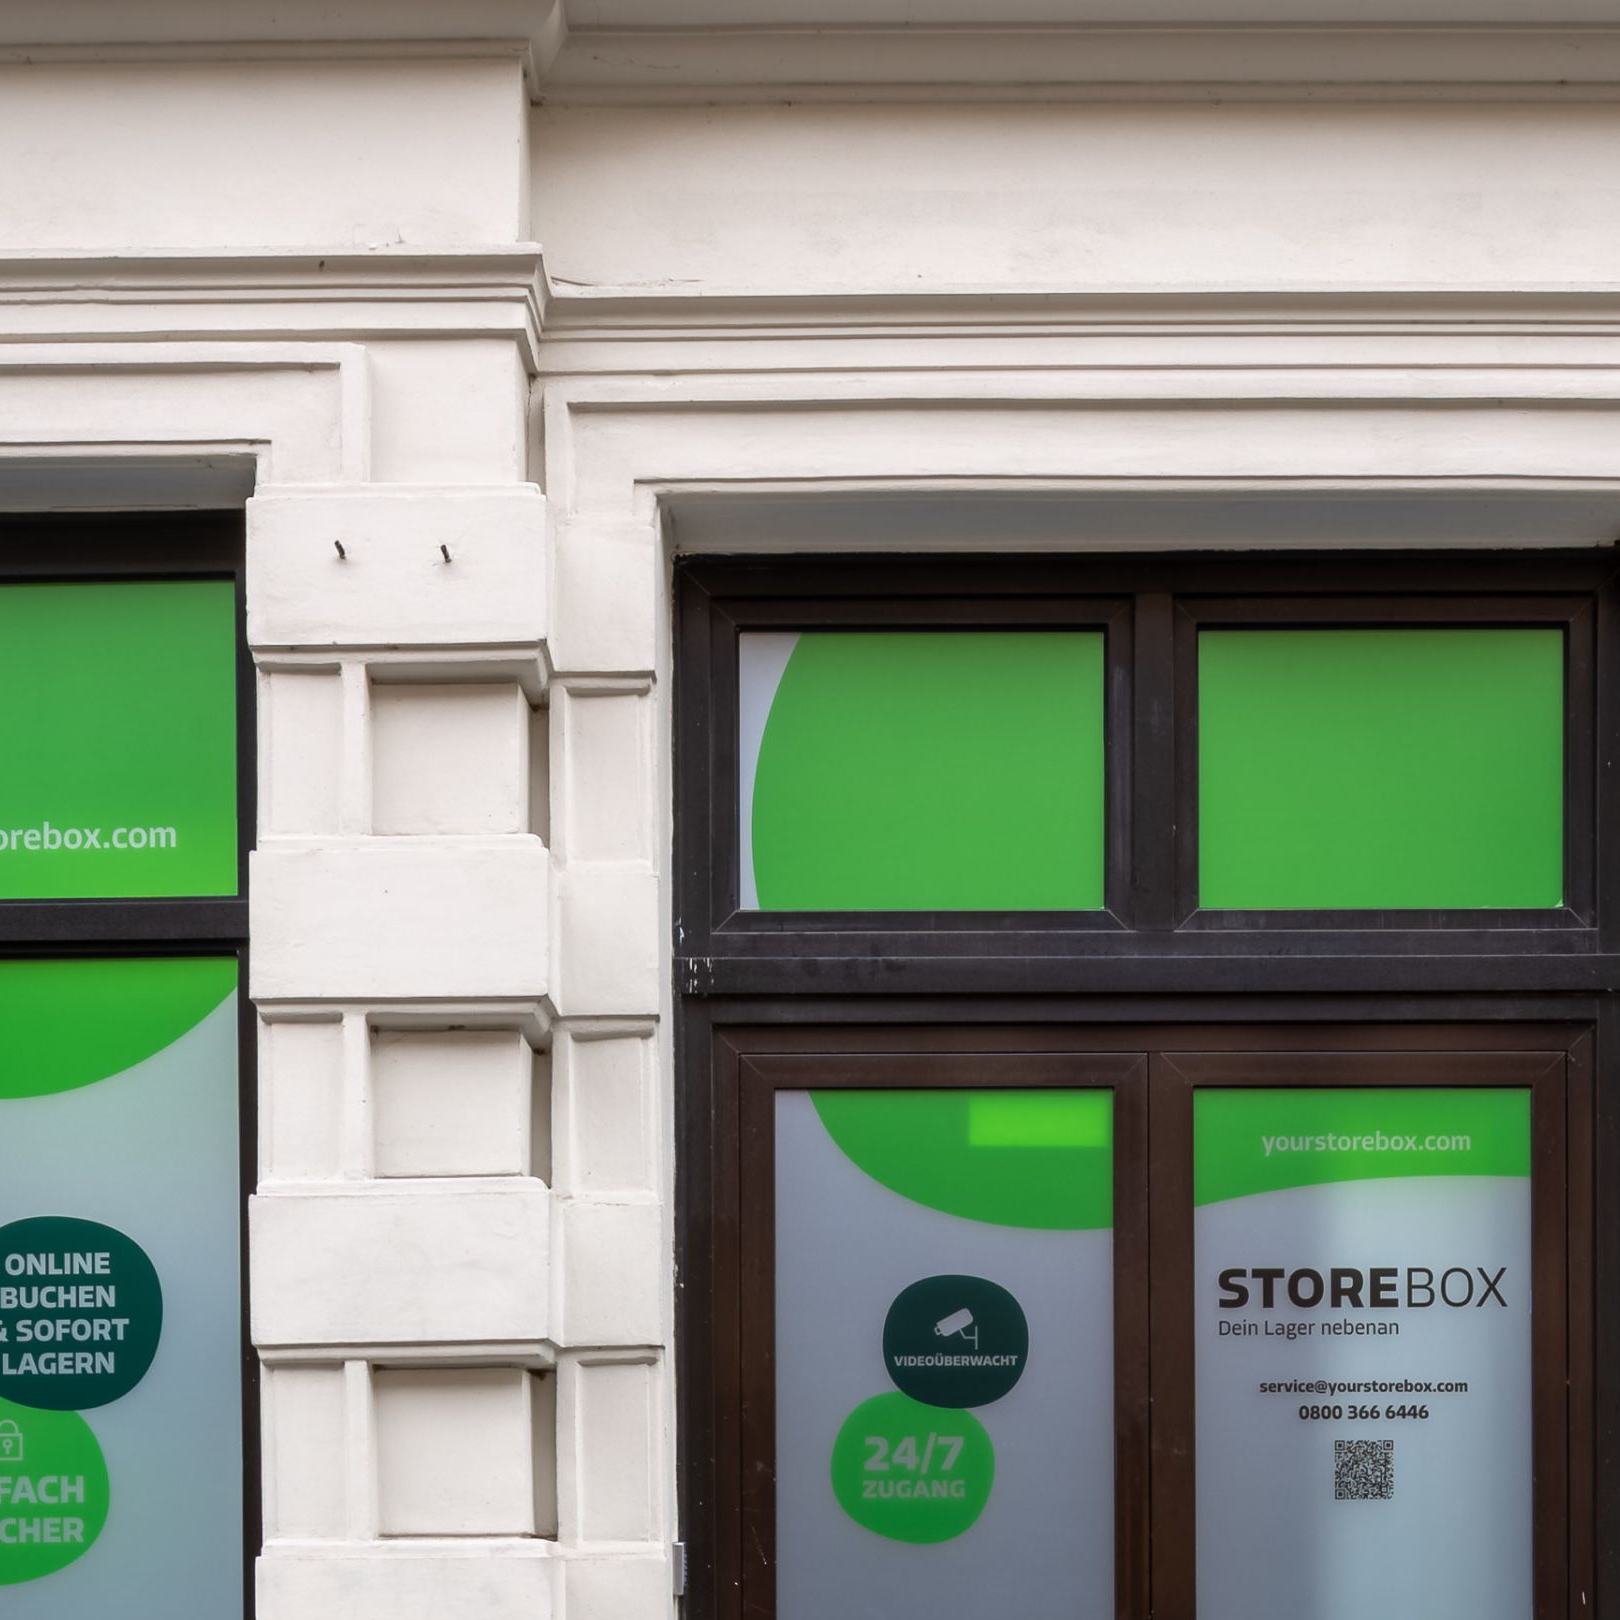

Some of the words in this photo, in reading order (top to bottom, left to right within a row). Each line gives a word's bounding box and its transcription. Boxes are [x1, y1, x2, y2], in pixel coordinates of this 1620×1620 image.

[1261, 1129, 1472, 1157] yourstorebox.com
[4, 1252, 111, 1276] ONLINE
[0, 1285, 116, 1309] BUCHEN
[1218, 1266, 1508, 1309] STOREBOX
[15, 1318, 130, 1341] SOFORT
[1219, 1320, 1258, 1336] Dein
[1264, 1319, 1315, 1340] Lager
[1321, 1319, 1399, 1336] nebenan
[2, 1352, 115, 1375] LAGERN
[894, 1352, 1018, 1367] VIDEOÜBERWACHT
[1259, 1379, 1469, 1396] service@yourstorebox.com
[1298, 1405, 1343, 1420] 0800
[1347, 1405, 1380, 1420] 366
[1385, 1405, 1429, 1420] 6446
[863, 1432, 965, 1474] 24/7
[862, 1479, 966, 1499] ZUGANG
